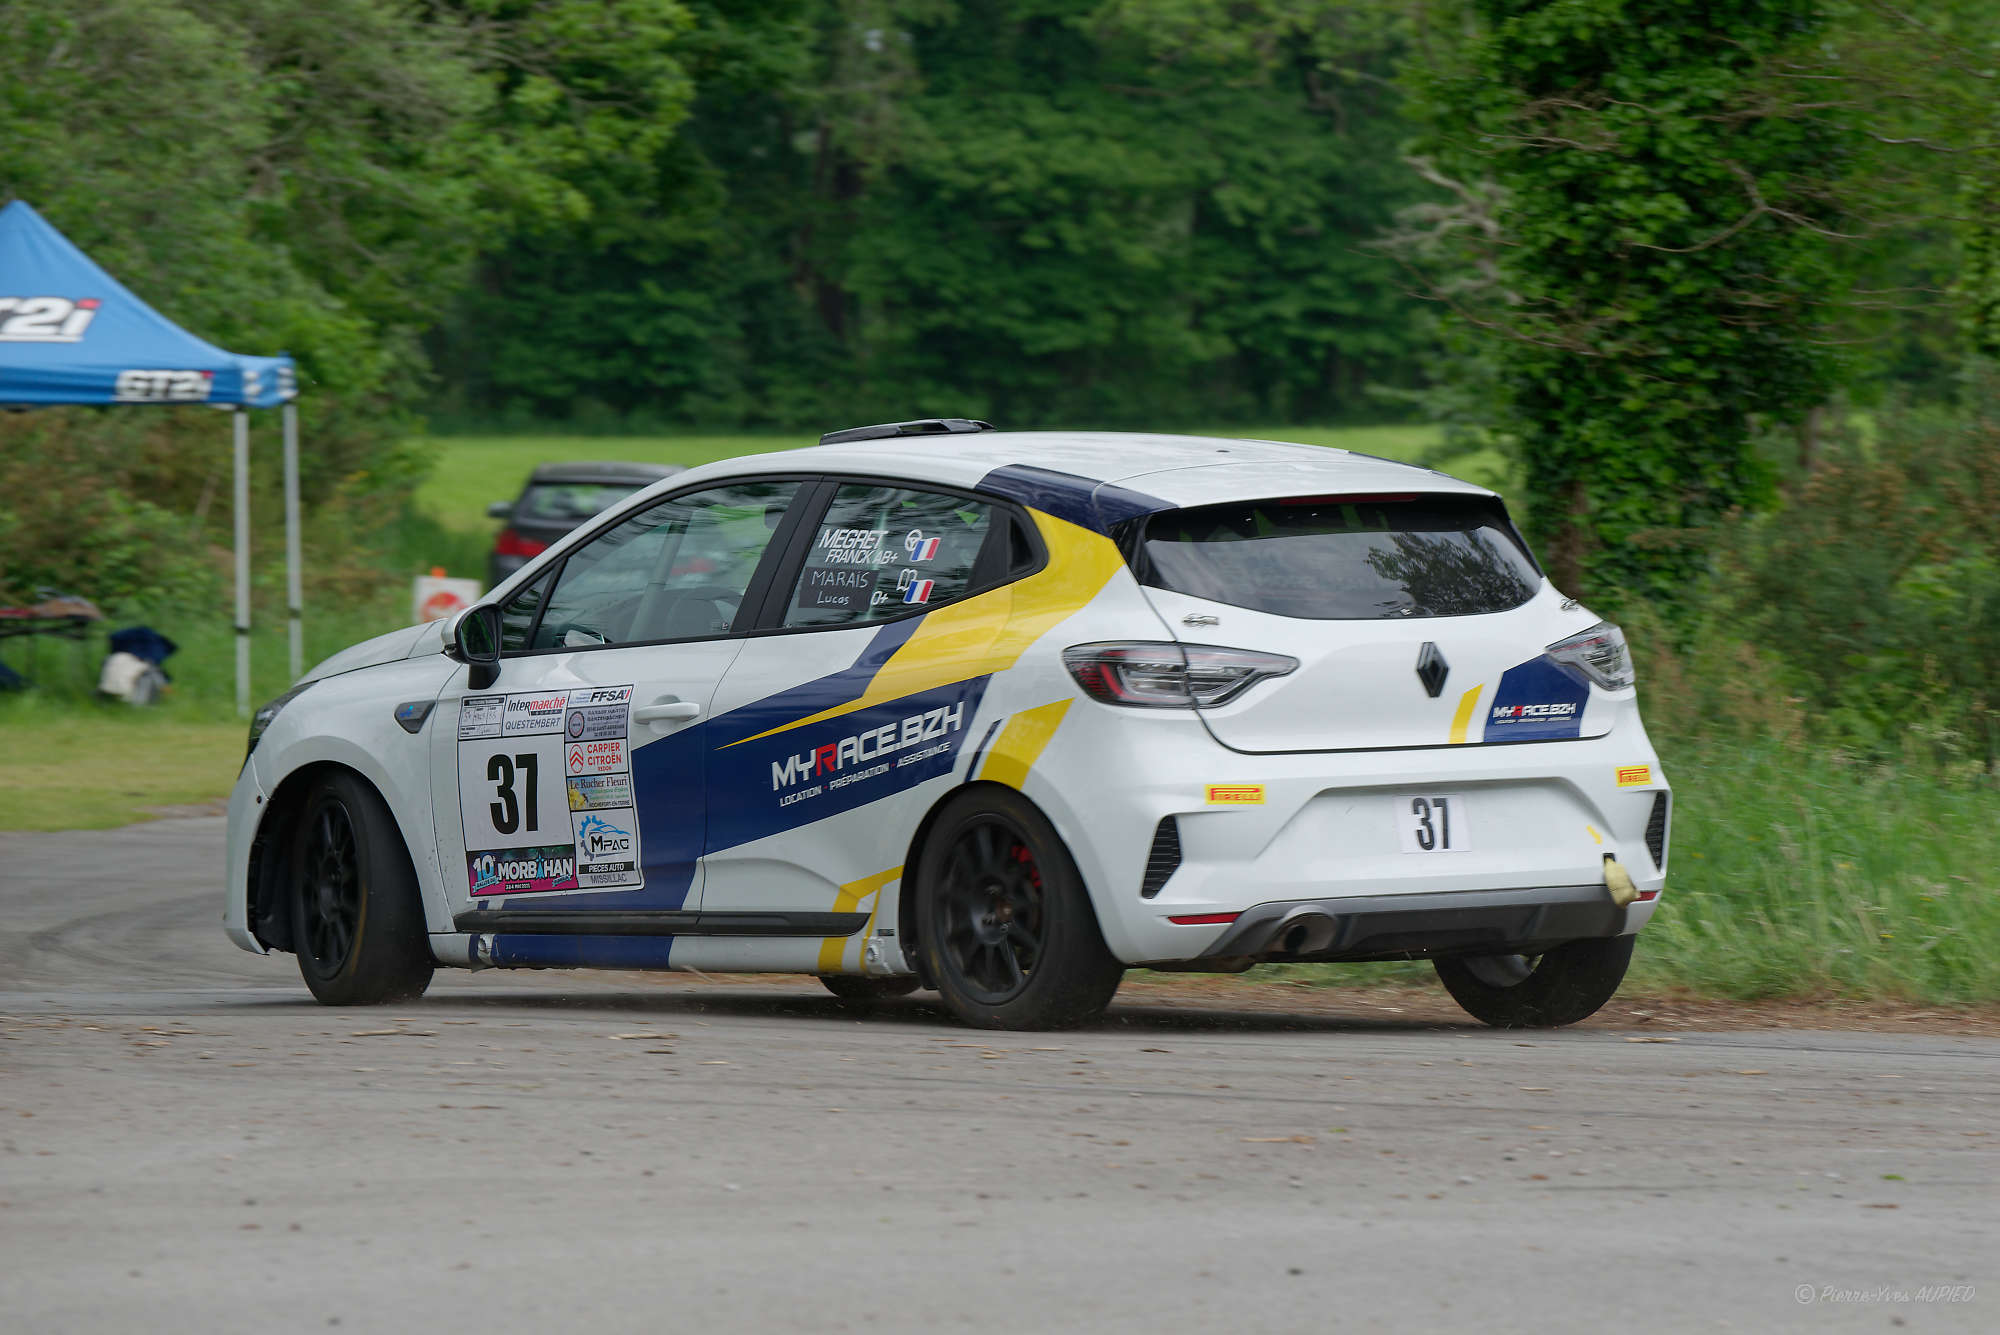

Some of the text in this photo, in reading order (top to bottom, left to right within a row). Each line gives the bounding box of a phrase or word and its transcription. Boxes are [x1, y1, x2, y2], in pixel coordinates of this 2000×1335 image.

[818, 529, 889, 549] MEGRET
[825, 549, 899, 564] FRANCK AB+
[816, 591, 849, 605] Lucas
[590, 690, 625, 702] FFSA
[506, 718, 561, 730] QUESTEMBERT
[587, 742, 620, 753] CARPIER
[771, 701, 965, 791] MYRACE.BZH
[587, 752, 622, 766] CITROËN
[780, 742, 951, 807] LOCATION PRÉPARATION ASSISTANCE
[570, 776, 627, 789] Le Rucher Fleuri
[487, 753, 538, 834] 37
[1412, 798, 1449, 850] 37
[591, 836, 629, 852] MPAC
[609, 863, 625, 871] AUTO
[590, 874, 627, 883] MISSILLAC
